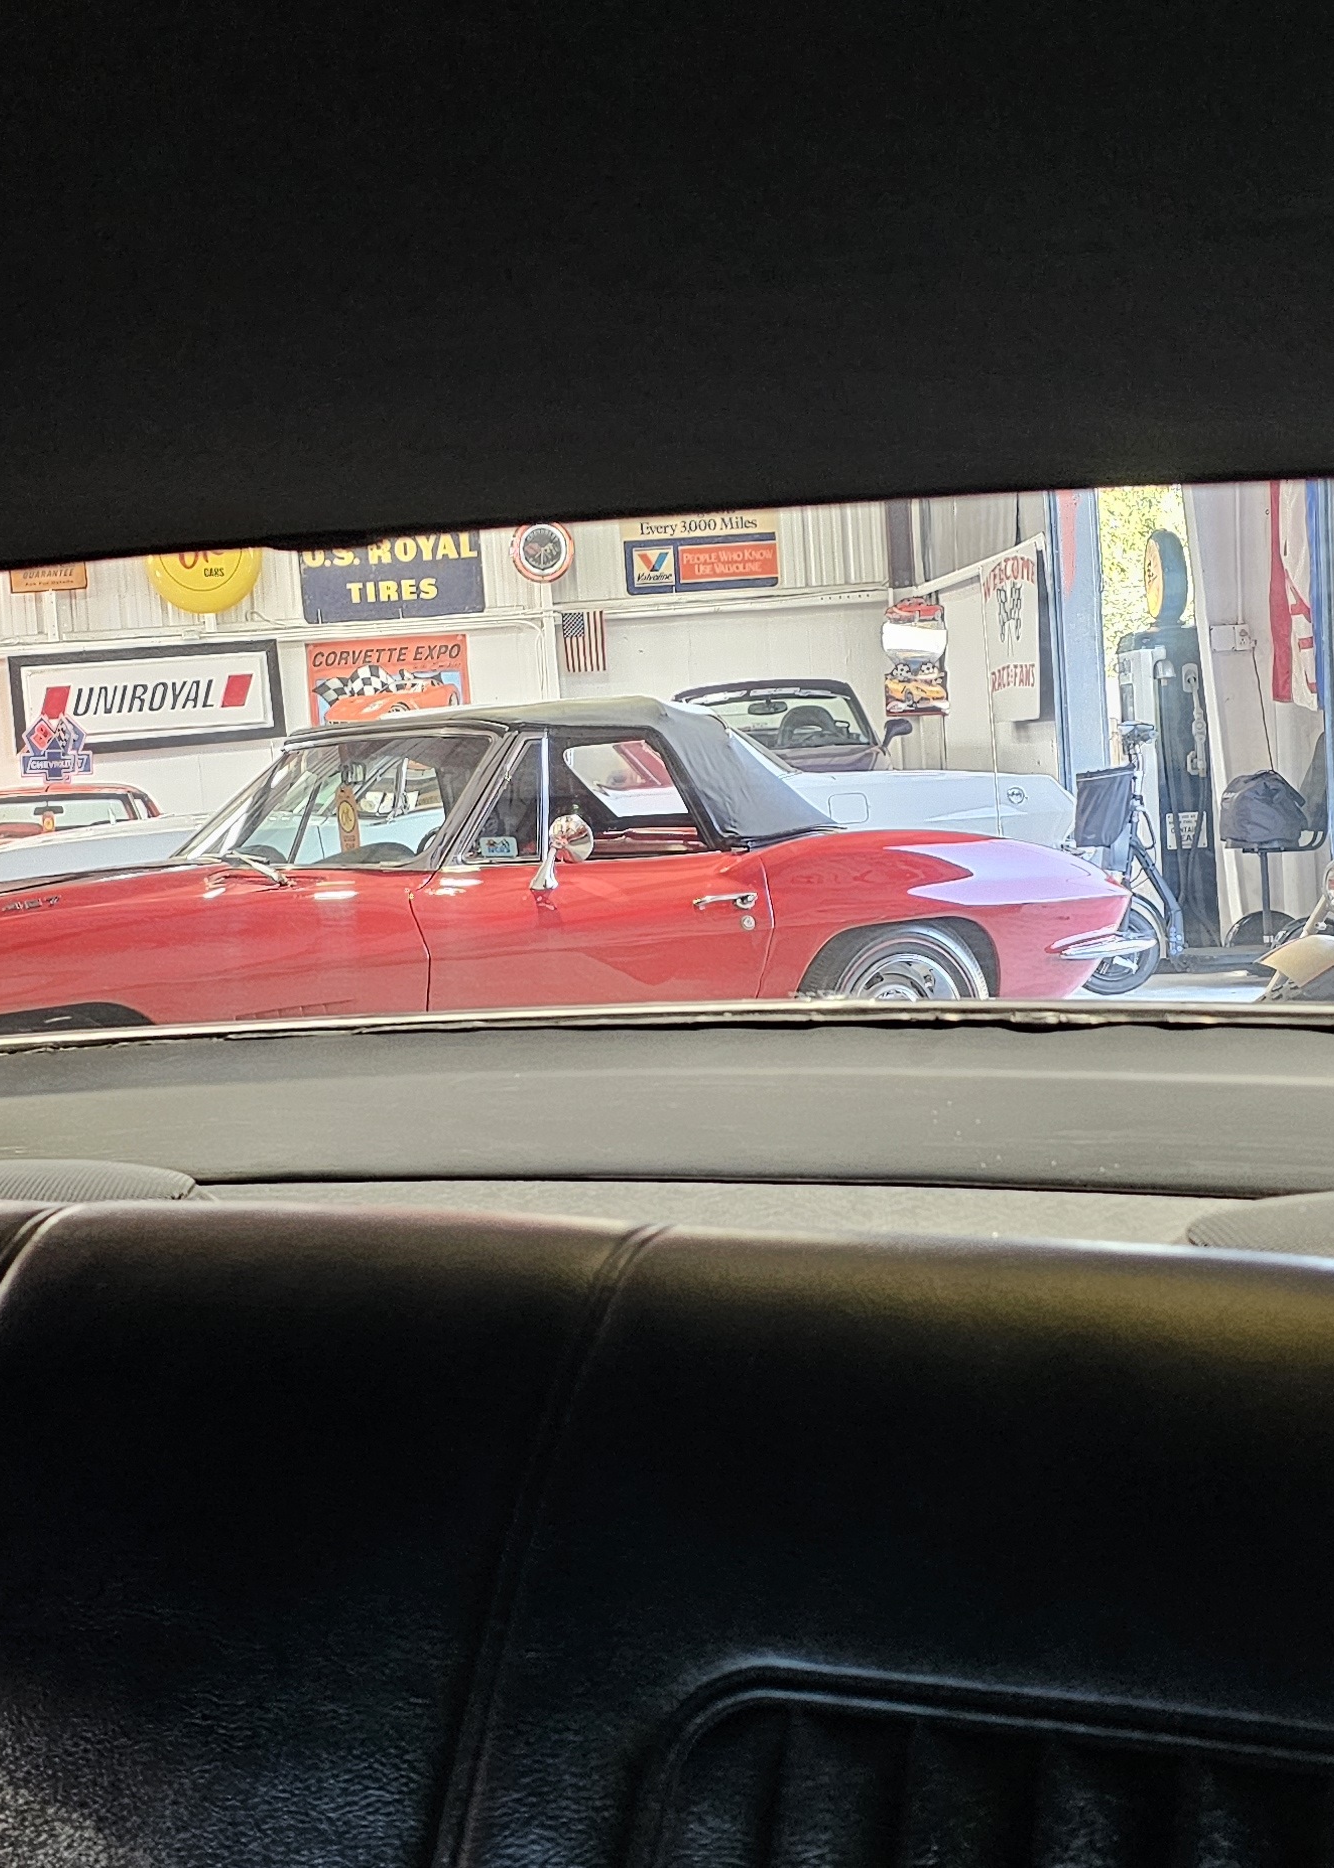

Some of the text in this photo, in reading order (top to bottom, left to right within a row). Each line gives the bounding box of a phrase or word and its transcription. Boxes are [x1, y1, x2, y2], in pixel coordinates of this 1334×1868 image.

[640, 517, 757, 536] Every 3,000 Miles
[303, 532, 478, 568] U.S. ROYAL
[683, 549, 773, 565] PEOPLE WHO KNOW
[204, 568, 225, 577] CARS
[637, 572, 673, 583] Valvoline
[694, 561, 762, 576] USE VALVOLINE
[982, 555, 1036, 600] WELCOME
[346, 577, 438, 604] TIRES
[312, 643, 461, 668] CORVETTE EXPO
[72, 678, 215, 717] UNIROYAL
